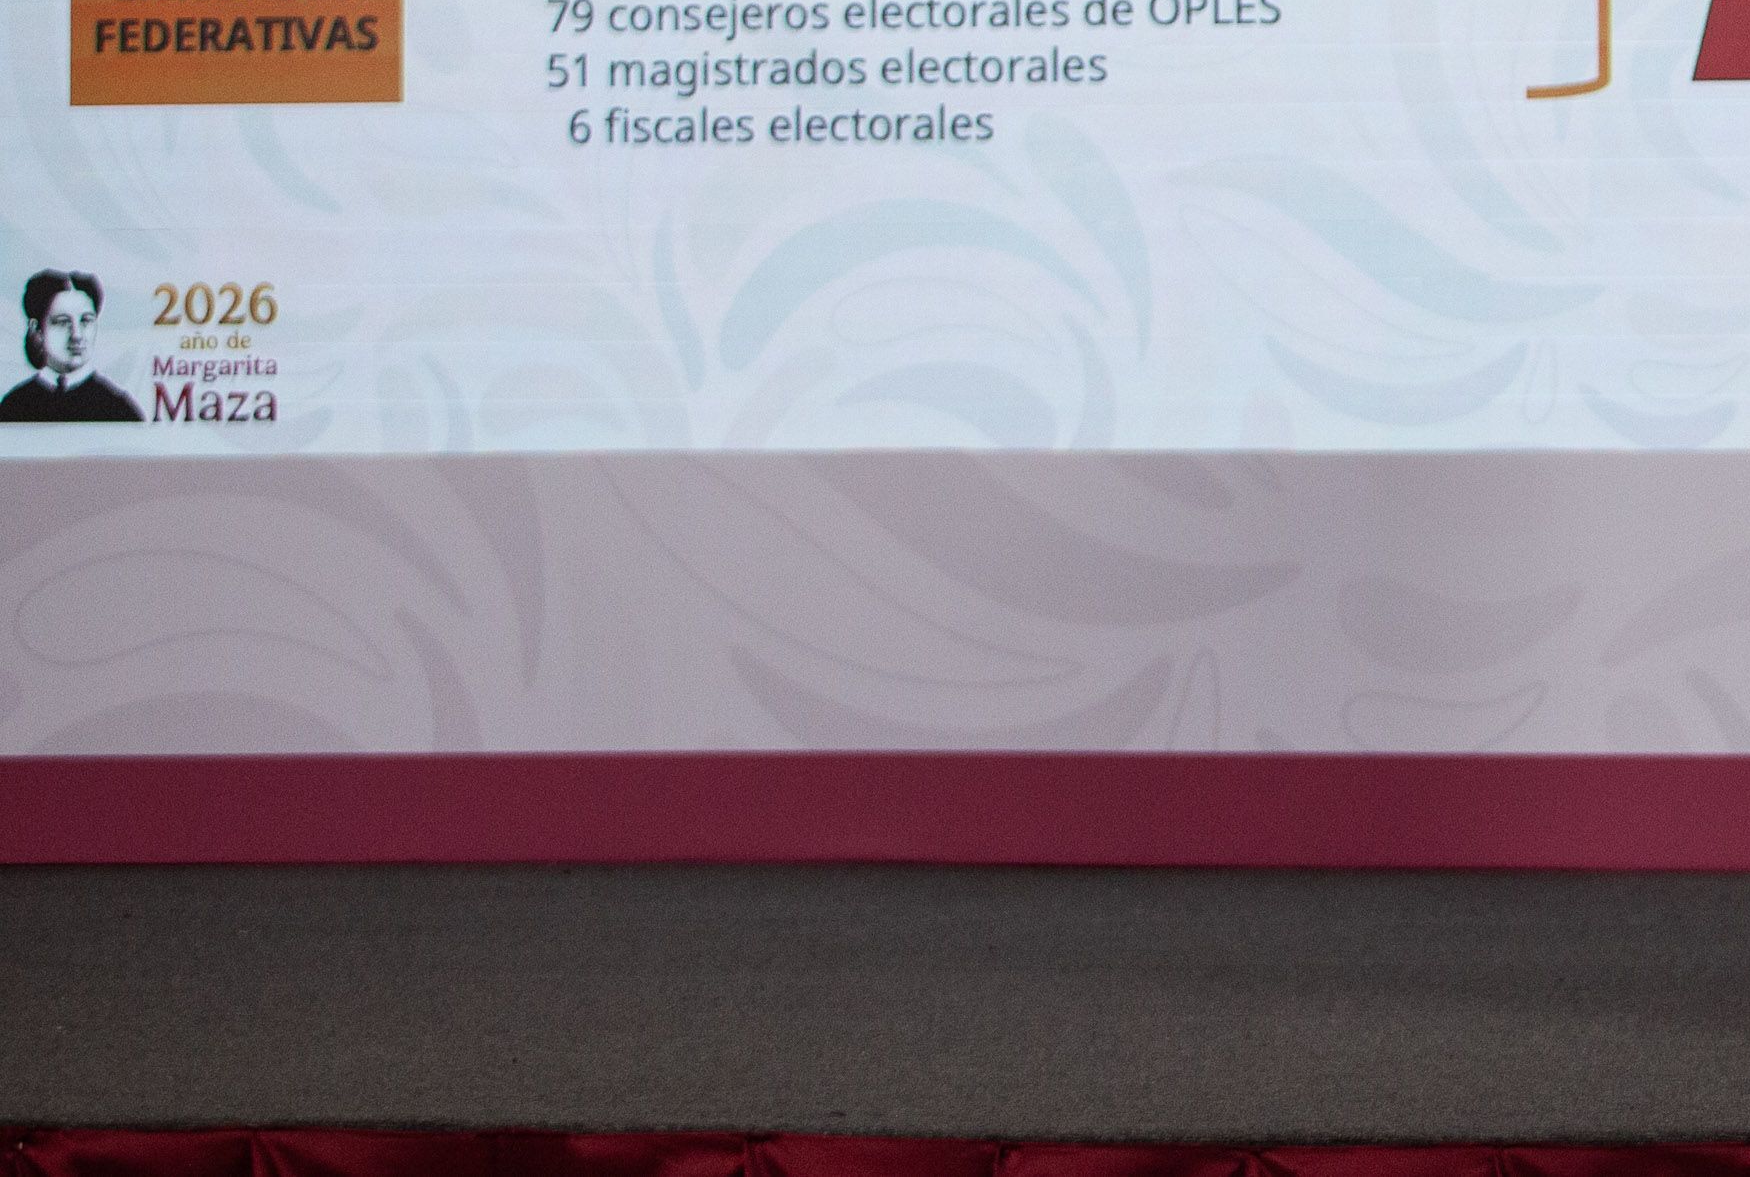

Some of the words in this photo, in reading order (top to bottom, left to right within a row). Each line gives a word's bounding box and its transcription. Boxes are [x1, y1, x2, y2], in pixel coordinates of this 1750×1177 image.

[94, 16, 379, 54] FEDERATIVAS
[547, 53, 589, 88] 51
[609, 49, 867, 97] magistrados
[880, 47, 1108, 87] electorales
[569, 110, 592, 144] 6
[604, 106, 756, 144] fiscales
[769, 104, 994, 143] electorales
[153, 281, 278, 326] 2026
[180, 331, 218, 350] año
[227, 331, 252, 349] de
[152, 355, 279, 382] Margarita
[152, 381, 278, 423] Maza
